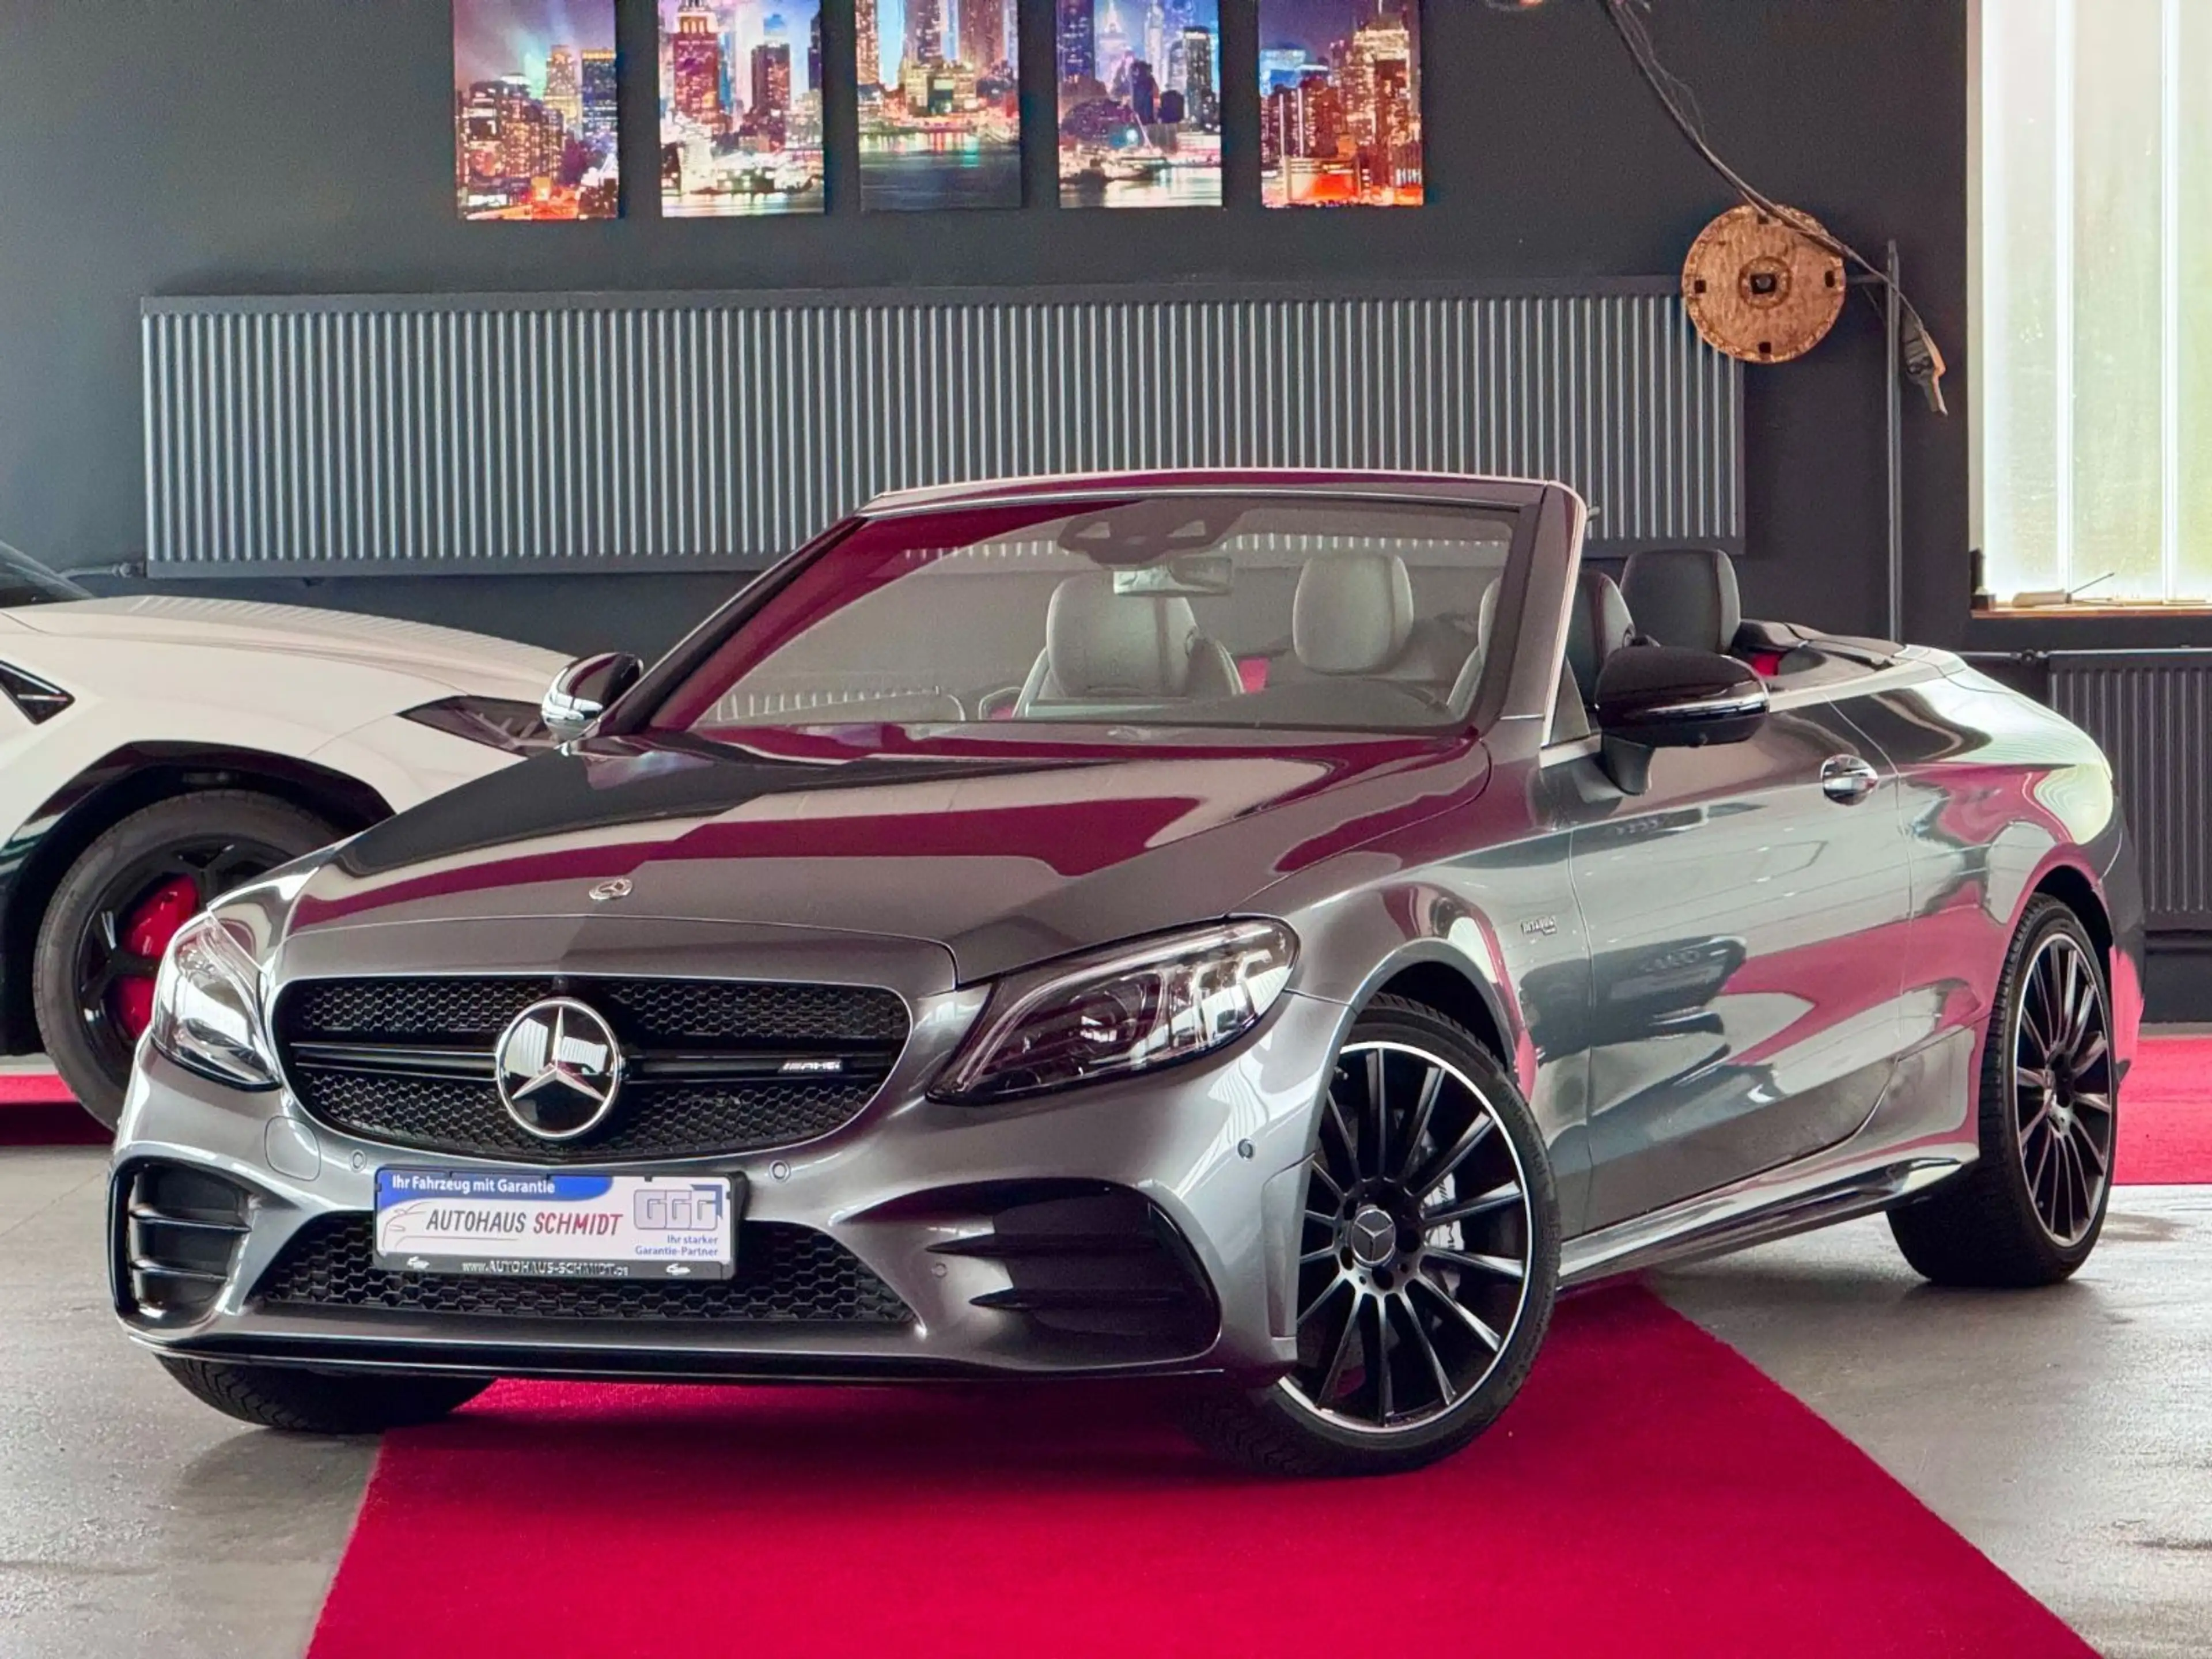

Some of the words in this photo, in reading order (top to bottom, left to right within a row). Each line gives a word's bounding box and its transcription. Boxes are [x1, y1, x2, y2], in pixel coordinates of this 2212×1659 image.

[392, 1175, 410, 1188] Ihr
[411, 1175, 471, 1194] Fahrzeug
[472, 1177, 495, 1192] mit
[497, 1179, 556, 1194] Garantie
[426, 1209, 527, 1233] AUTOHAUS
[533, 1211, 624, 1237] SCHMIDT
[666, 1234, 682, 1244] Ihr
[683, 1234, 718, 1245] starker
[635, 1245, 718, 1257] Garantie-Partner
